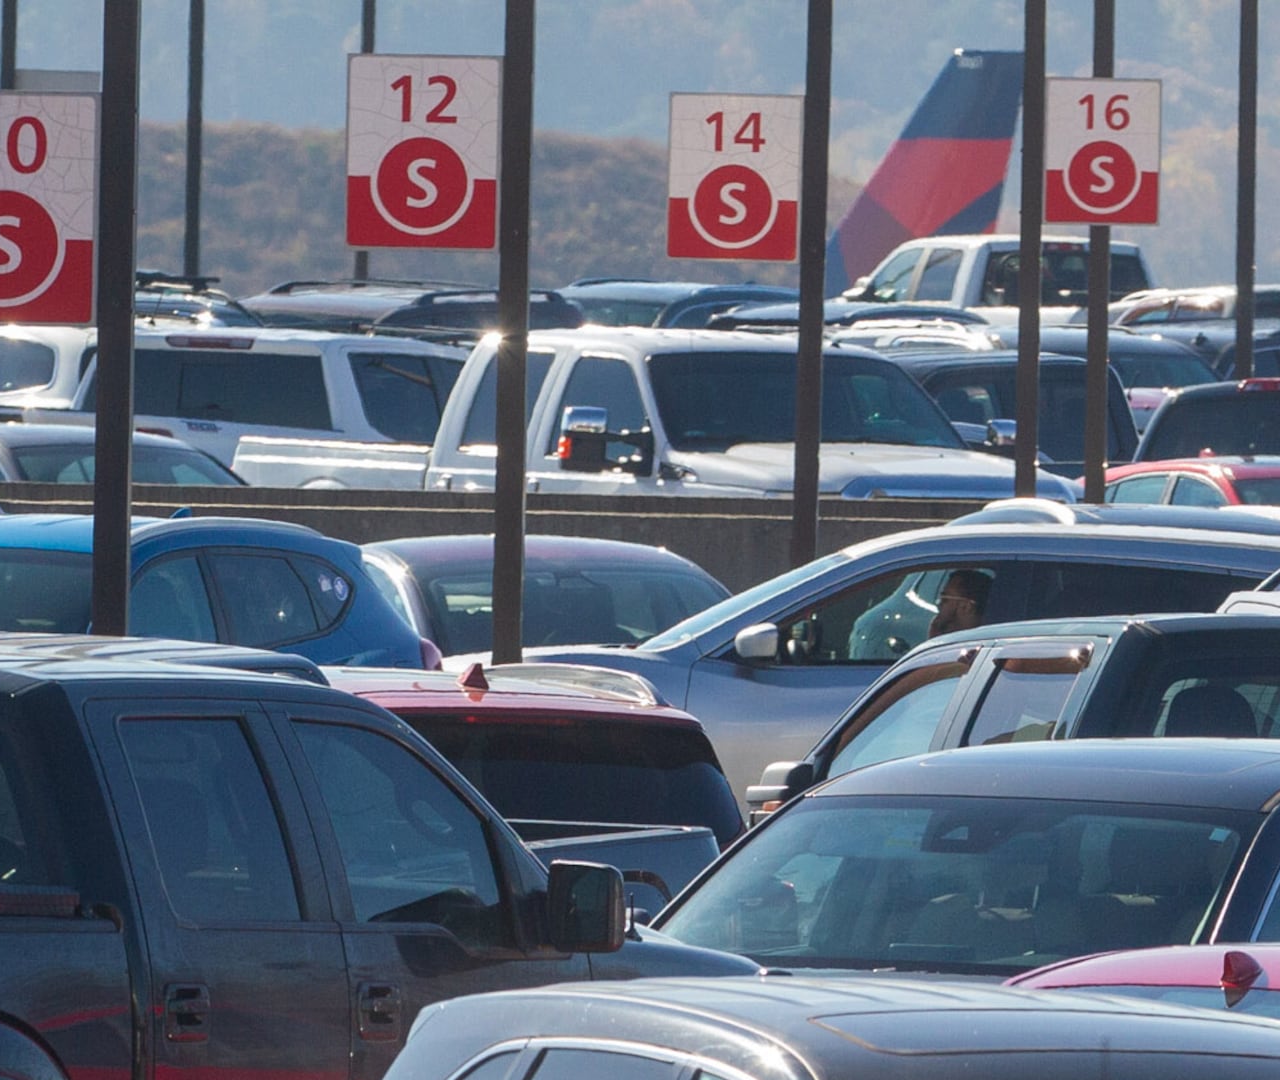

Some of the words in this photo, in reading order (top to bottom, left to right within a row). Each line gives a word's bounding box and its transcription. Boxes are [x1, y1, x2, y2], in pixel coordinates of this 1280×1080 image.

[391, 75, 457, 124] 12
[1078, 94, 1131, 131] 16
[705, 111, 766, 153] 14
[406, 158, 439, 208] S
[1089, 155, 1115, 194] S
[718, 181, 748, 225] S
